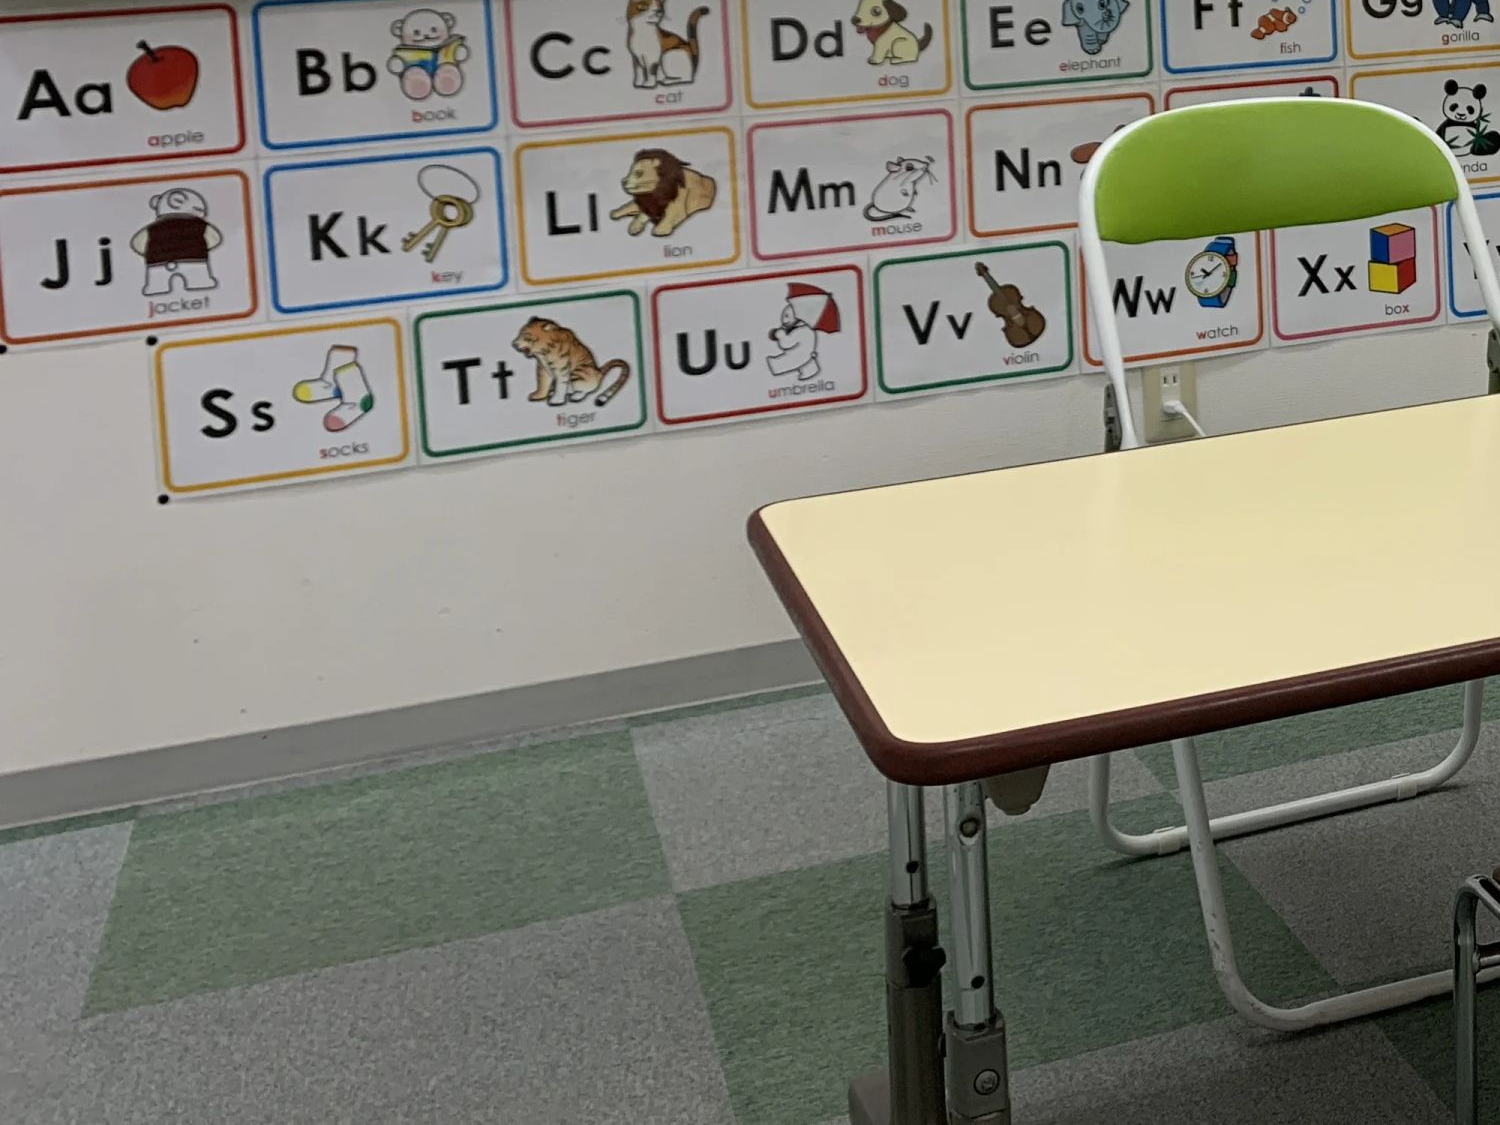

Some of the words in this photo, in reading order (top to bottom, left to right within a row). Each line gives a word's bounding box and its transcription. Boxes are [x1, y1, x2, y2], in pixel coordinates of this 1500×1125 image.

[770, 16, 846, 63] Dd
[1441, 29, 1481, 46] gorilla
[529, 31, 613, 80] Cc
[1279, 41, 1301, 55] fish
[296, 47, 378, 97] Bb
[1058, 55, 1122, 73] elephant
[877, 72, 910, 89] dog
[17, 68, 113, 121] Aa
[654, 90, 685, 105] cat
[411, 107, 458, 124] book
[147, 128, 204, 149] apple
[994, 146, 1062, 193] Nn
[767, 166, 857, 215] Mm
[871, 221, 923, 237] mouse
[663, 243, 694, 259] lion
[430, 269, 464, 287] key
[147, 294, 211, 318] jacket
[1384, 301, 1411, 317] box
[1195, 323, 1239, 341] watch
[676, 328, 752, 376] Uu
[1002, 351, 1040, 367] violin
[767, 378, 836, 400] umbrella
[556, 409, 597, 429] tiger
[318, 439, 369, 460] socks
